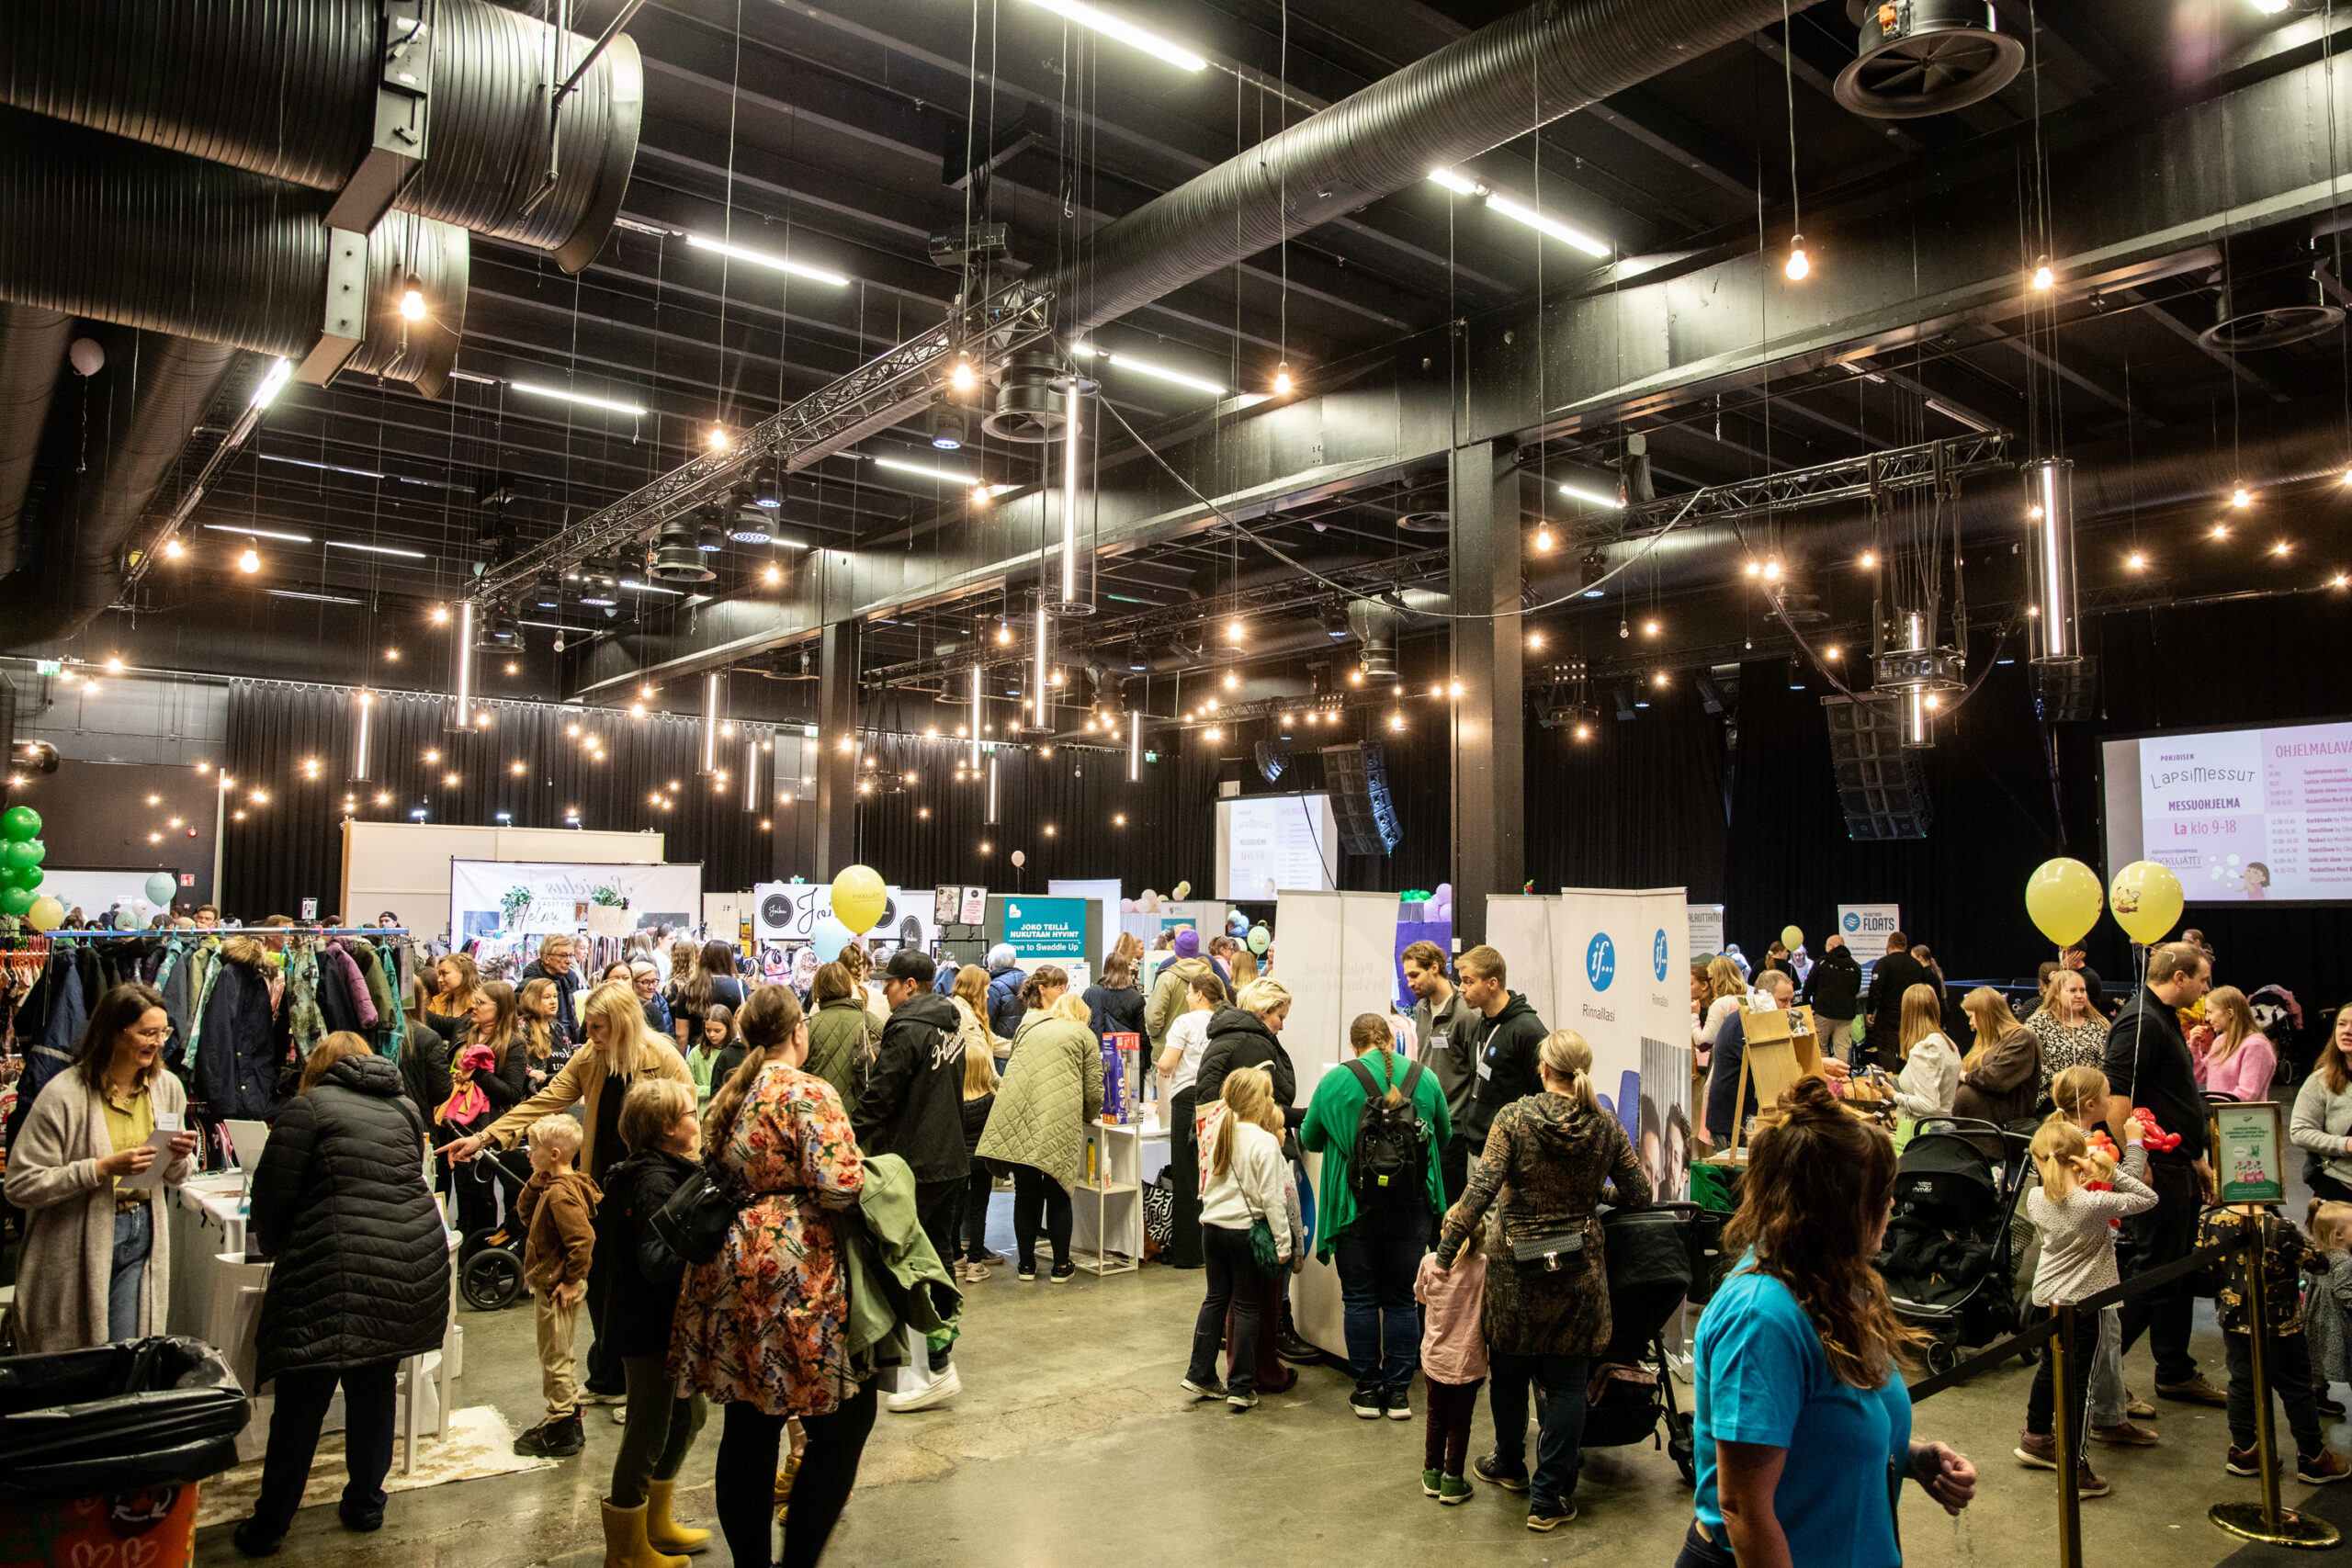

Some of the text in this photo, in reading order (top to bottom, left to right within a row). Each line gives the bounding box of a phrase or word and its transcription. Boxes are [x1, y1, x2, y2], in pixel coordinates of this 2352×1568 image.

[2160, 753, 2195, 761] POHJOISEN
[2168, 797, 2241, 812] MESSUOHJELMA
[2174, 818, 2236, 836] La klo 9-18
[1021, 921, 1069, 931] JOKO TEILLÄ
[1863, 917, 1895, 931] FLOATS
[1035, 942, 1067, 952] Swaddle
[1582, 1003, 1616, 1022] Rinnallasi
